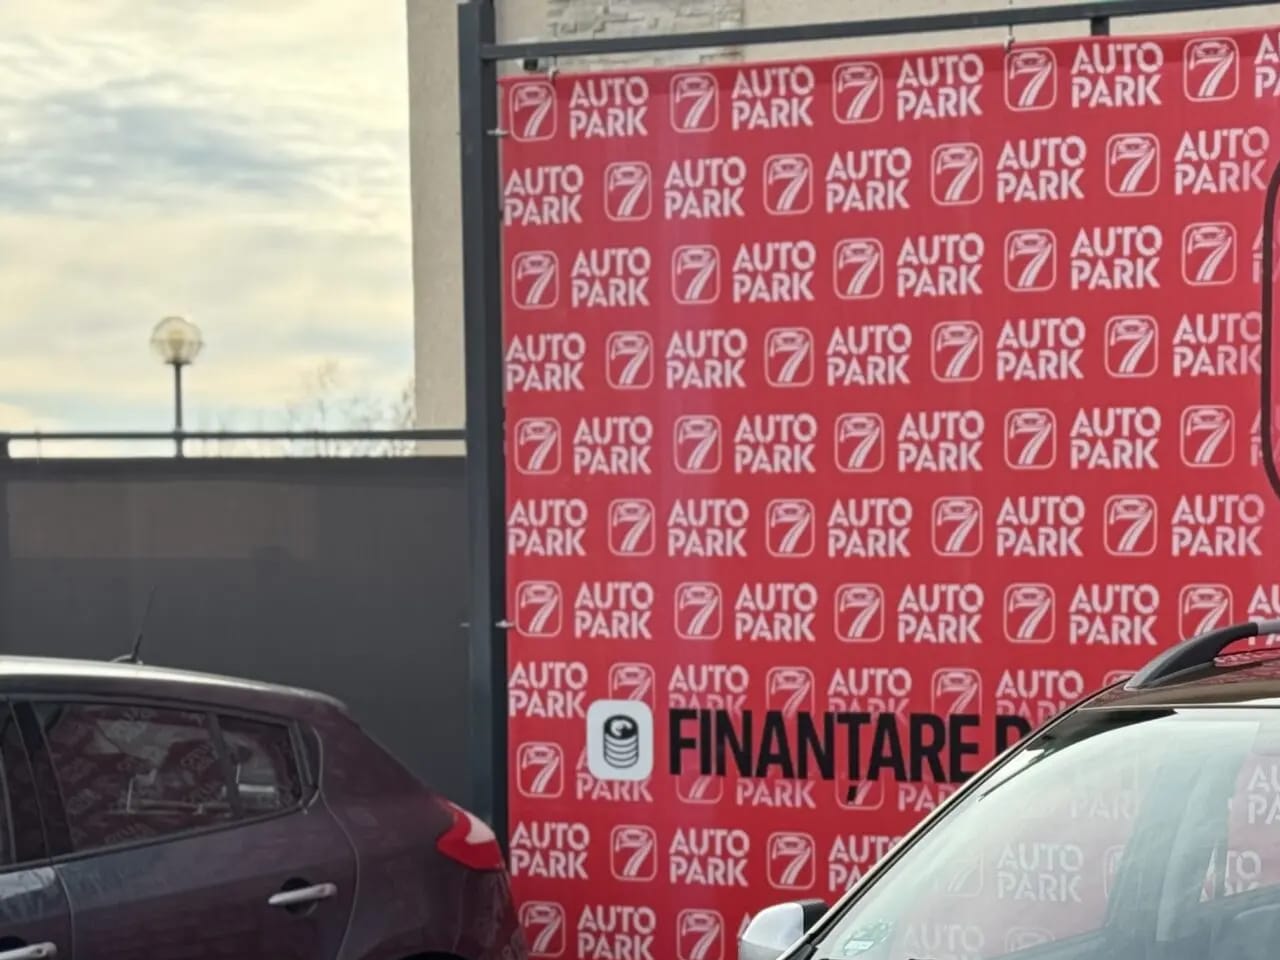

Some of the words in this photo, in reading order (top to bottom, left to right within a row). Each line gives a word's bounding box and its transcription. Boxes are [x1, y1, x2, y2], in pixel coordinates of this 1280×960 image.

[897, 53, 983, 88] AUTO
[1071, 42, 1163, 74] AUTO
[569, 76, 649, 108] AUTO
[732, 66, 814, 99] AUTO
[1072, 74, 1161, 108] PARK
[733, 96, 813, 130] PARK
[898, 85, 982, 120] PARK
[570, 107, 647, 139] PARK
[997, 136, 1086, 170] AUTO
[1175, 127, 1269, 162] AUTO
[664, 157, 746, 188] AUTO
[826, 148, 911, 181] AUTO
[1175, 160, 1266, 194] PARK
[504, 165, 583, 196] AUTO
[827, 179, 909, 212] PARK
[998, 168, 1084, 202] PARK
[504, 194, 581, 225] PARK
[665, 187, 744, 219] PARK
[897, 233, 984, 266] AUTO
[1071, 225, 1162, 257] AUTO
[572, 247, 650, 277] AUTO
[733, 241, 816, 272] AUTO
[734, 272, 814, 302] PARK
[898, 264, 982, 297] PARK
[1072, 257, 1159, 289] PARK
[572, 277, 649, 307] PARK
[827, 324, 912, 355] AUTO
[997, 317, 1085, 348] AUTO
[1173, 312, 1262, 344] AUTO
[505, 333, 585, 362] AUTO
[666, 329, 747, 358] AUTO
[667, 359, 745, 388] PARK
[828, 355, 909, 386] PARK
[997, 349, 1083, 380] PARK
[1174, 344, 1261, 376] PARK
[506, 362, 584, 391] PARK
[574, 416, 652, 444] AUTO
[734, 414, 817, 443] AUTO
[898, 410, 984, 441] AUTO
[1070, 407, 1161, 437] AUTO
[574, 446, 651, 474] PARK
[735, 444, 815, 473] PARK
[899, 441, 982, 472] PARK
[1071, 438, 1158, 469] PARK
[507, 499, 587, 527] AUTO
[668, 499, 748, 526] AUTO
[828, 498, 912, 527] AUTO
[997, 496, 1085, 525] AUTO
[1172, 495, 1264, 524] AUTO
[508, 528, 585, 555] PARK
[669, 528, 746, 556] PARK
[829, 528, 910, 557] PARK
[997, 527, 1082, 556] PARK
[1172, 526, 1261, 556] PARK
[575, 582, 653, 609] AUTO
[735, 583, 817, 612] AUTO
[898, 584, 984, 613] AUTO
[1070, 584, 1159, 614] AUTO
[575, 610, 651, 638] PARK
[736, 612, 815, 641] PARK
[898, 614, 981, 643] PARK
[1070, 615, 1156, 645] PARK
[508, 662, 587, 690] AUTO
[668, 664, 749, 694] AUTO
[828, 667, 912, 698] AUTO
[996, 669, 1084, 699] AUTO
[509, 690, 587, 718] PARK
[669, 709, 979, 803] FINANȚARE
[736, 779, 816, 809] PARK
[510, 822, 589, 850] AUTO
[669, 828, 749, 857] AUTO
[511, 847, 587, 878] PARK
[670, 855, 747, 886] PARK
[996, 843, 1084, 873] AUTO
[996, 872, 1083, 902] PARK
[578, 906, 656, 934] AUTO
